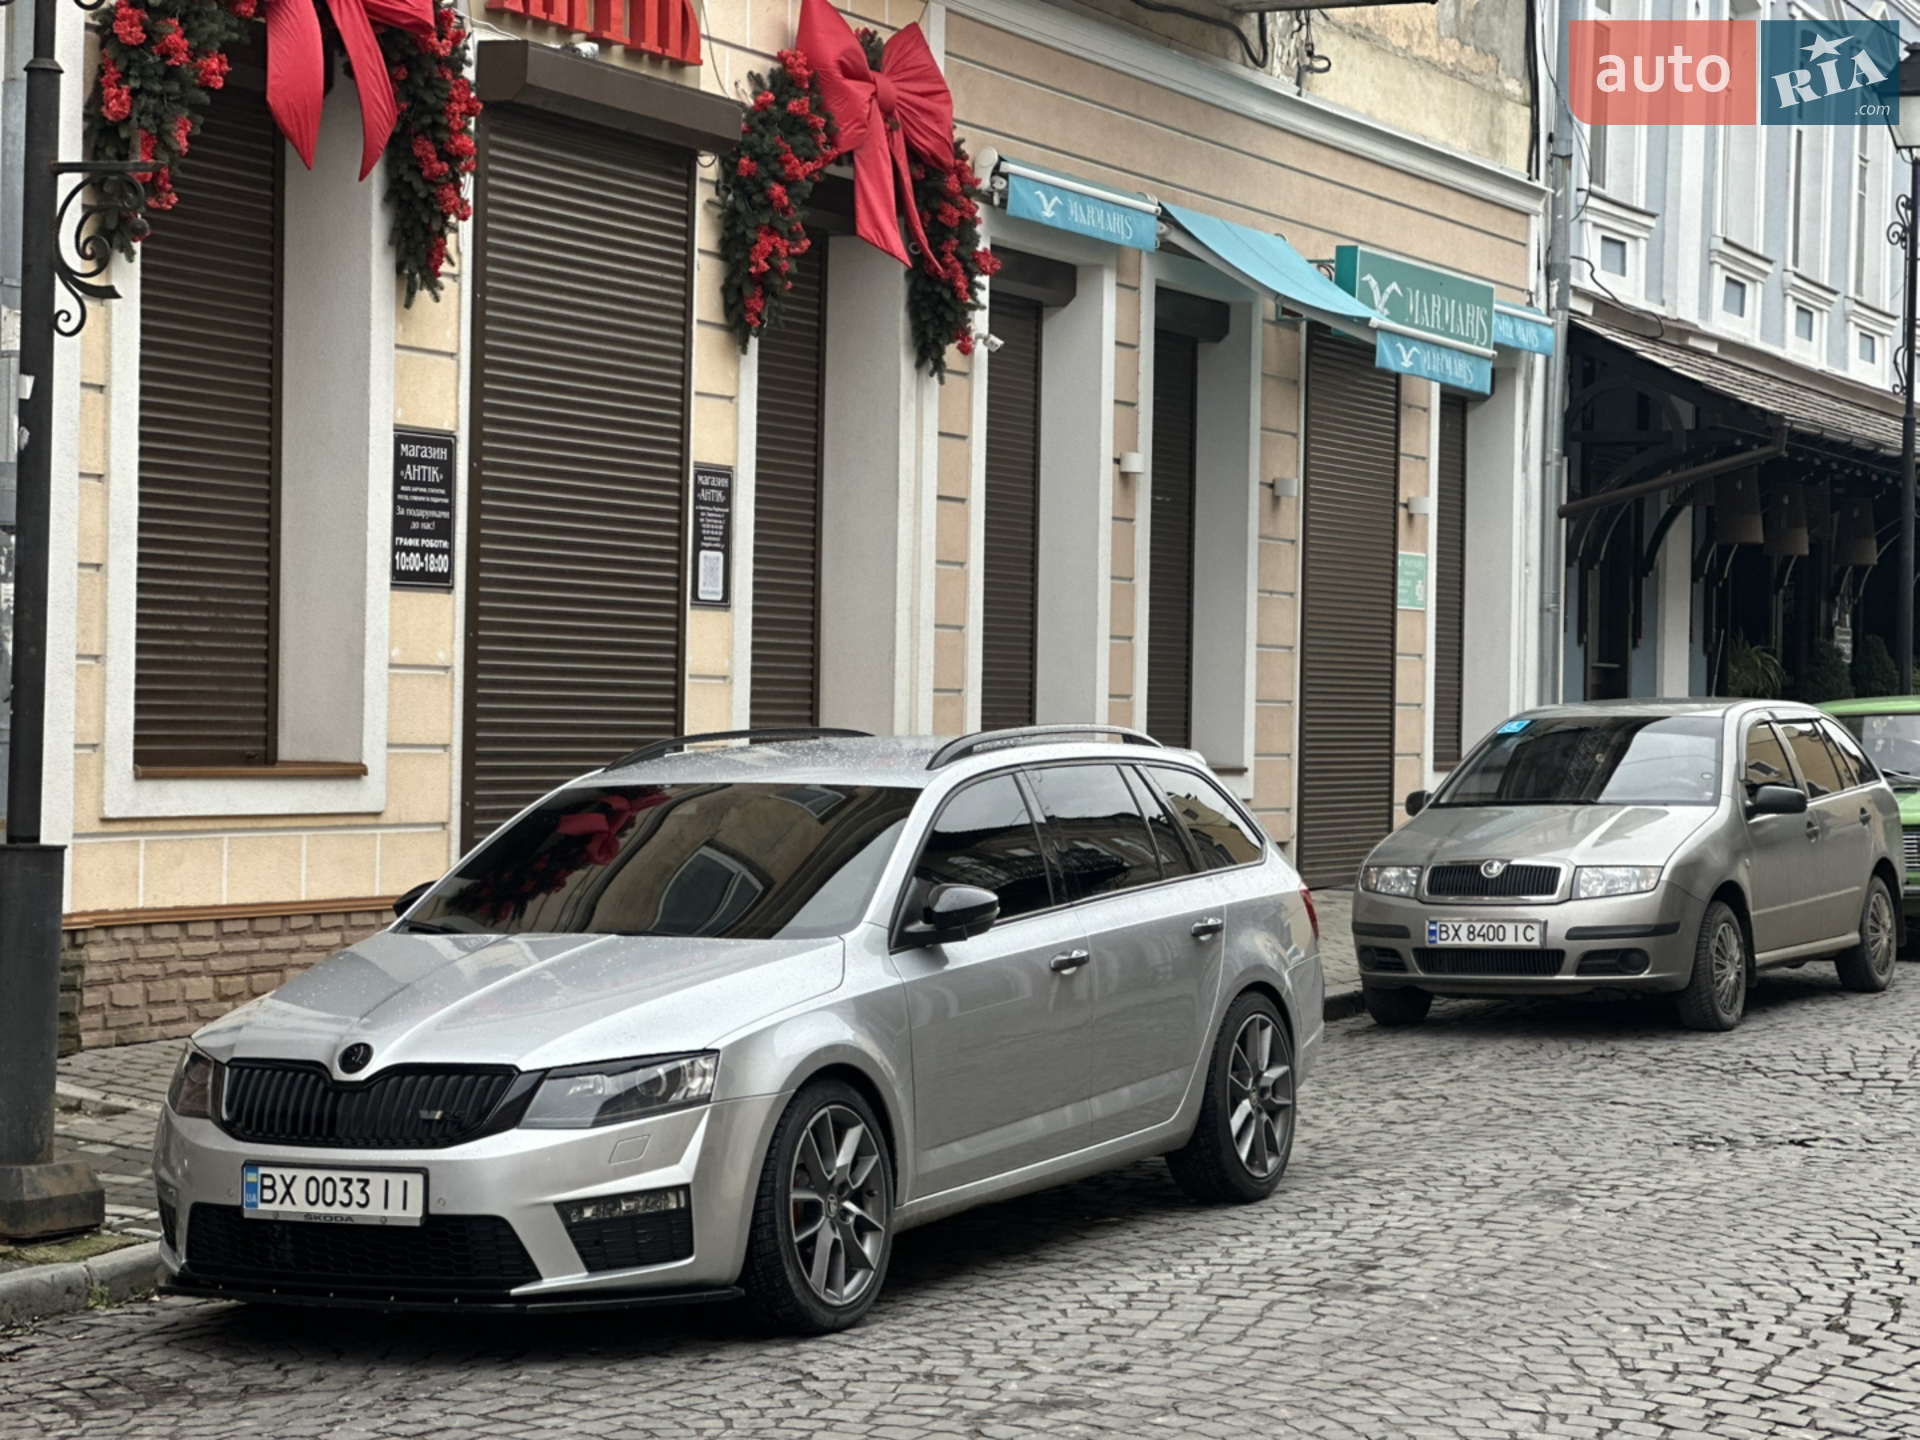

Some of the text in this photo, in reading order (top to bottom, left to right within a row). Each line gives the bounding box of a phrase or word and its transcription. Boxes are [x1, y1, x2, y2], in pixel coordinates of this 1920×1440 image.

[1067, 199, 1134, 240] MARMARIS
[1405, 286, 1488, 347] MARMARIS
[1421, 348, 1474, 385] MARMARIS
[400, 443, 448, 461] магазин
[395, 551, 450, 574] 10:00-18:00
[1438, 923, 1536, 943] BX 8400 IC
[260, 1173, 297, 1206] BX
[305, 1176, 370, 1209] 0033
